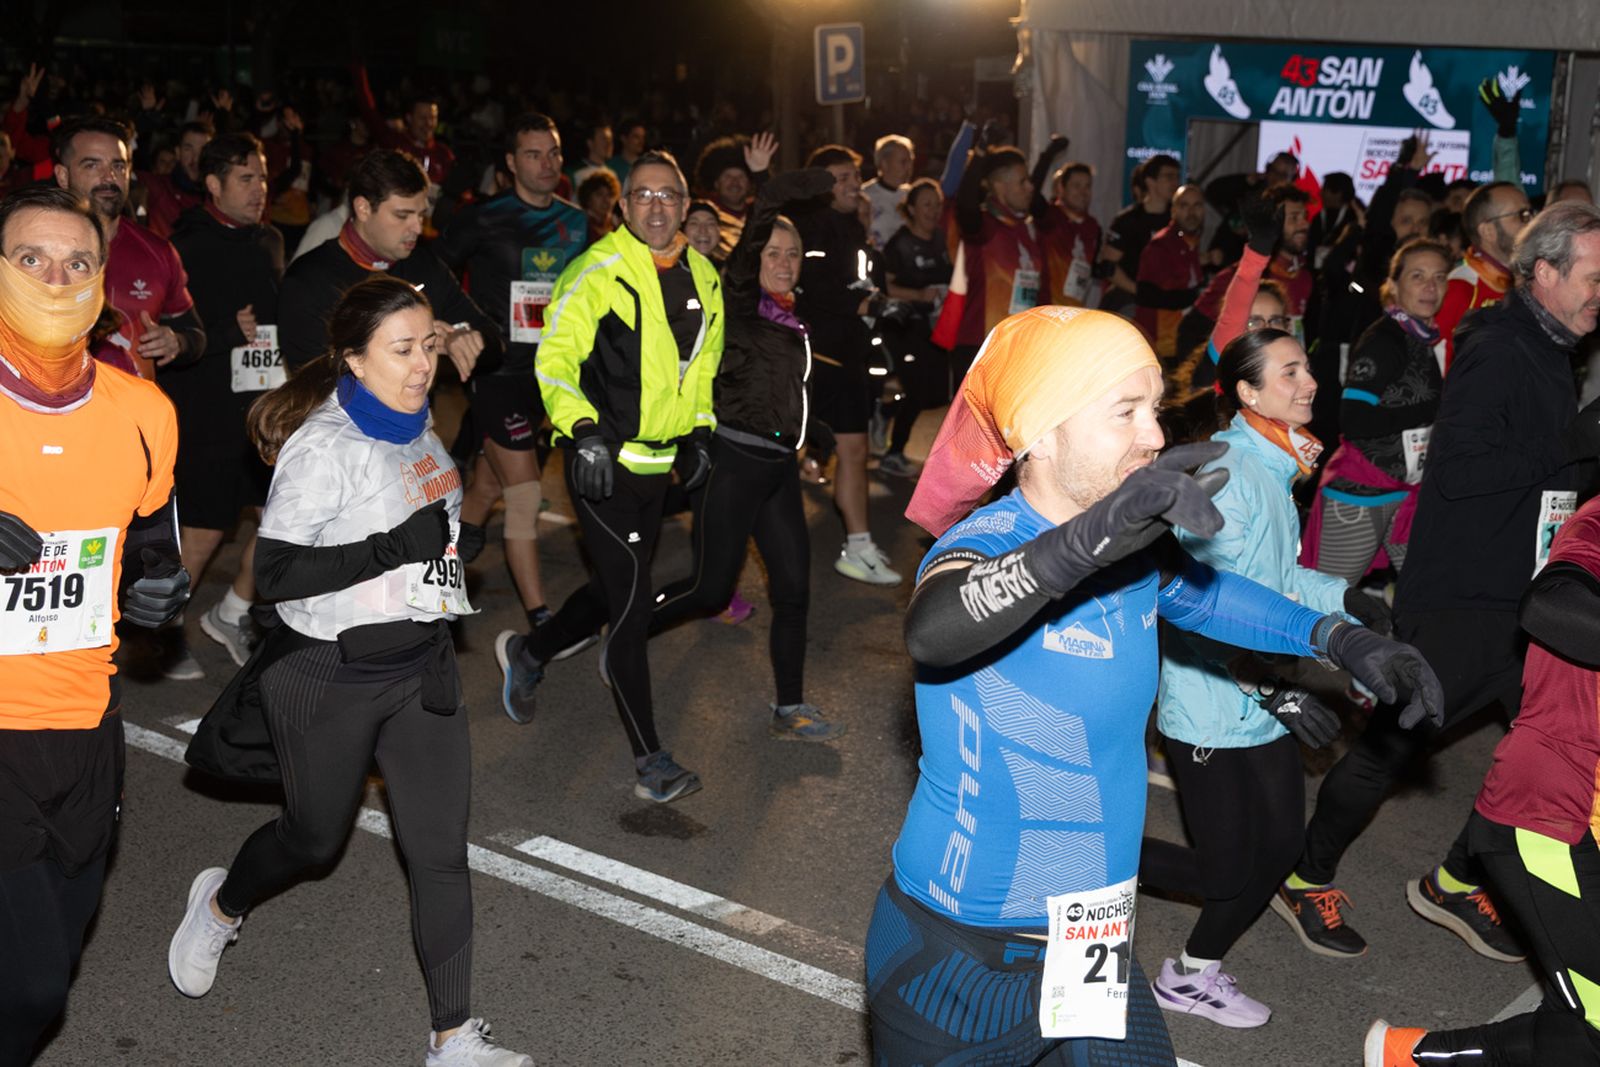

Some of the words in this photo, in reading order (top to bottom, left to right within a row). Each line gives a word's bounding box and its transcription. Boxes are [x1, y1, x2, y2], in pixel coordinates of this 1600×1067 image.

[827, 34, 854, 94] P
[1281, 54, 1319, 87] 43
[1318, 56, 1384, 87] SAN
[1217, 86, 1236, 106] 43
[1269, 82, 1375, 119] ANTÓN
[1419, 94, 1438, 115] 43
[242, 349, 283, 369] 4682
[54, 545, 68, 557] DE
[31, 559, 67, 574] NTON
[5, 573, 85, 611] 7519
[1066, 906, 1084, 918] 43
[1086, 902, 1128, 921] NOCHE
[1065, 926, 1098, 940] SAN
[1083, 943, 1128, 984] 21
